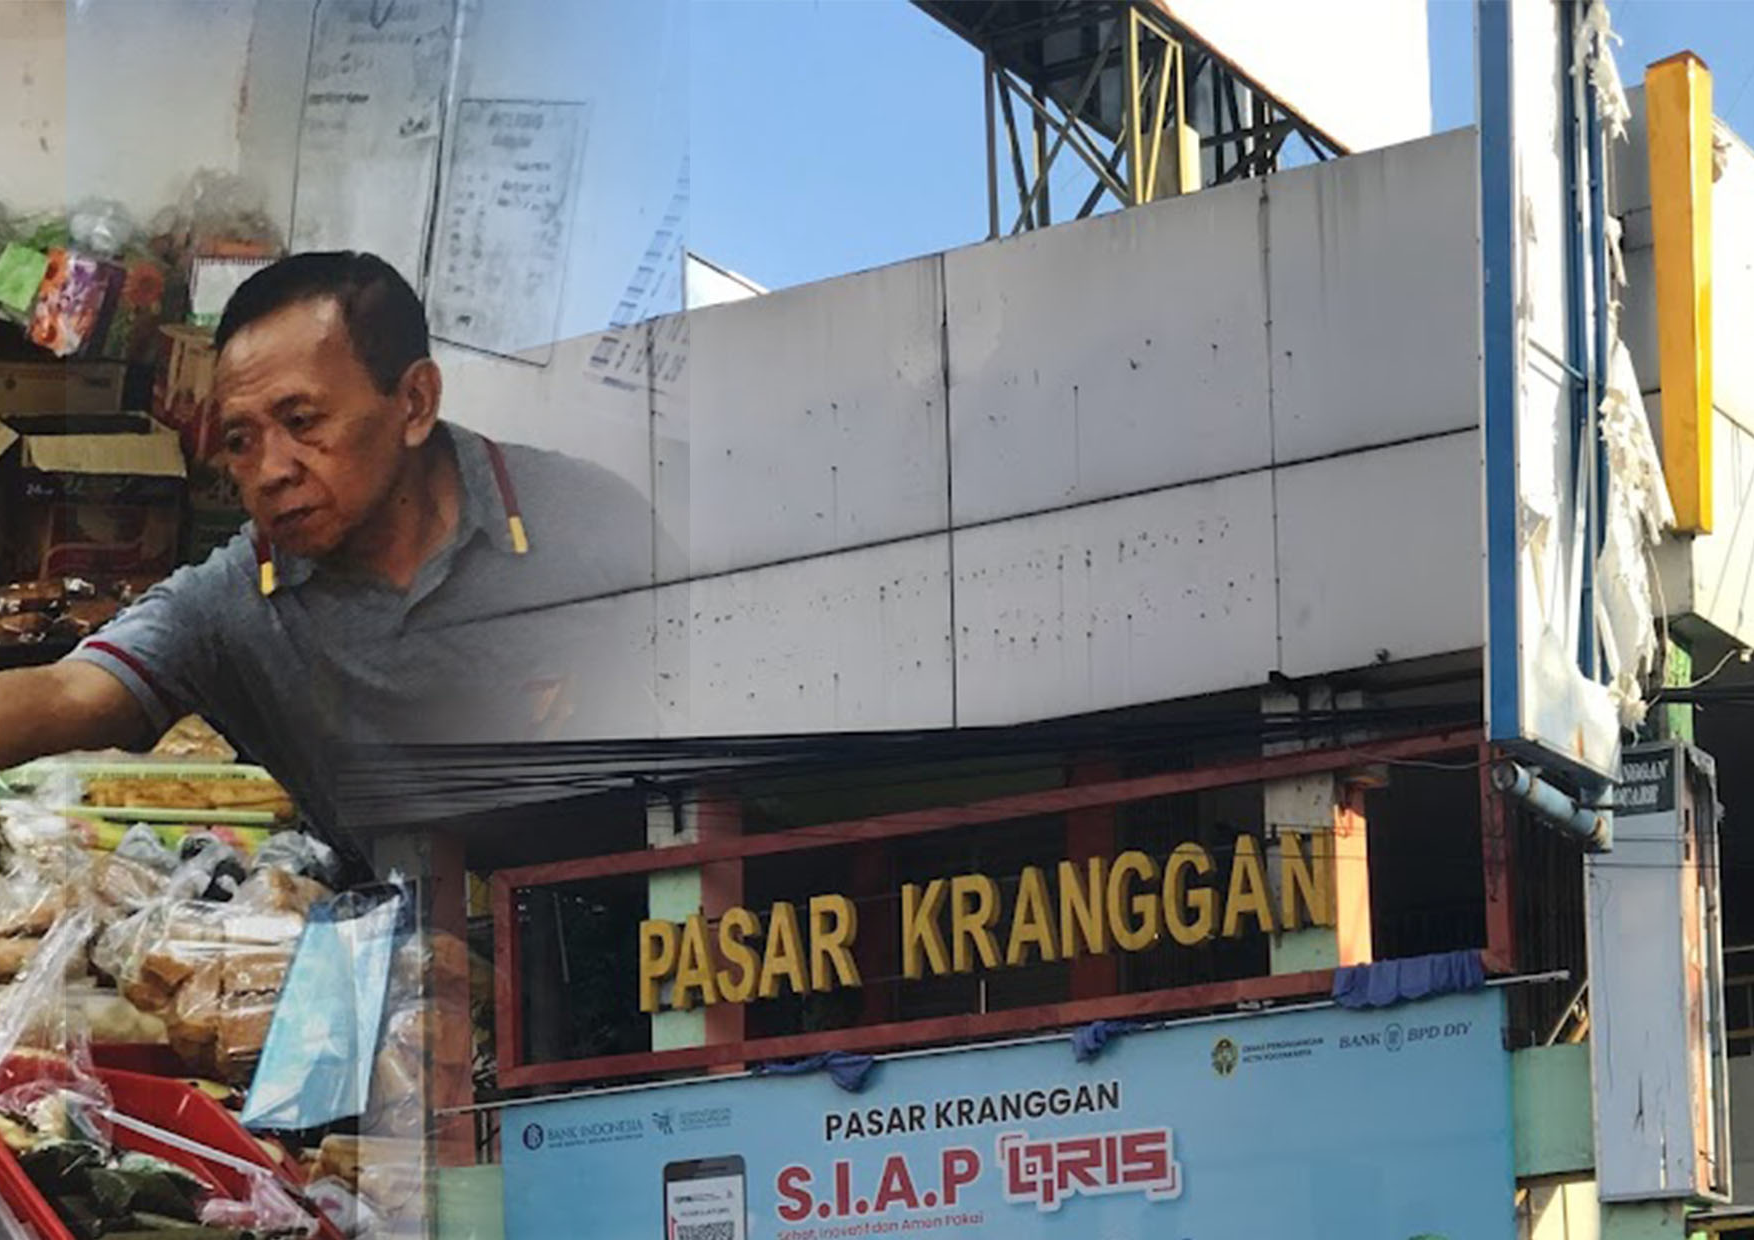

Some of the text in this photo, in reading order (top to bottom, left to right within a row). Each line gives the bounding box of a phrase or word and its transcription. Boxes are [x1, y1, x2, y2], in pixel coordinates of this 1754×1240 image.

[639, 828, 1336, 1013] PASAR KRANGGAN
[1338, 1033, 1381, 1050] BANK
[1406, 1026, 1441, 1042] BPD
[825, 1081, 1120, 1142] PASAR KRANGGAN
[776, 1130, 1168, 1222] S.I.A.P QRIS
